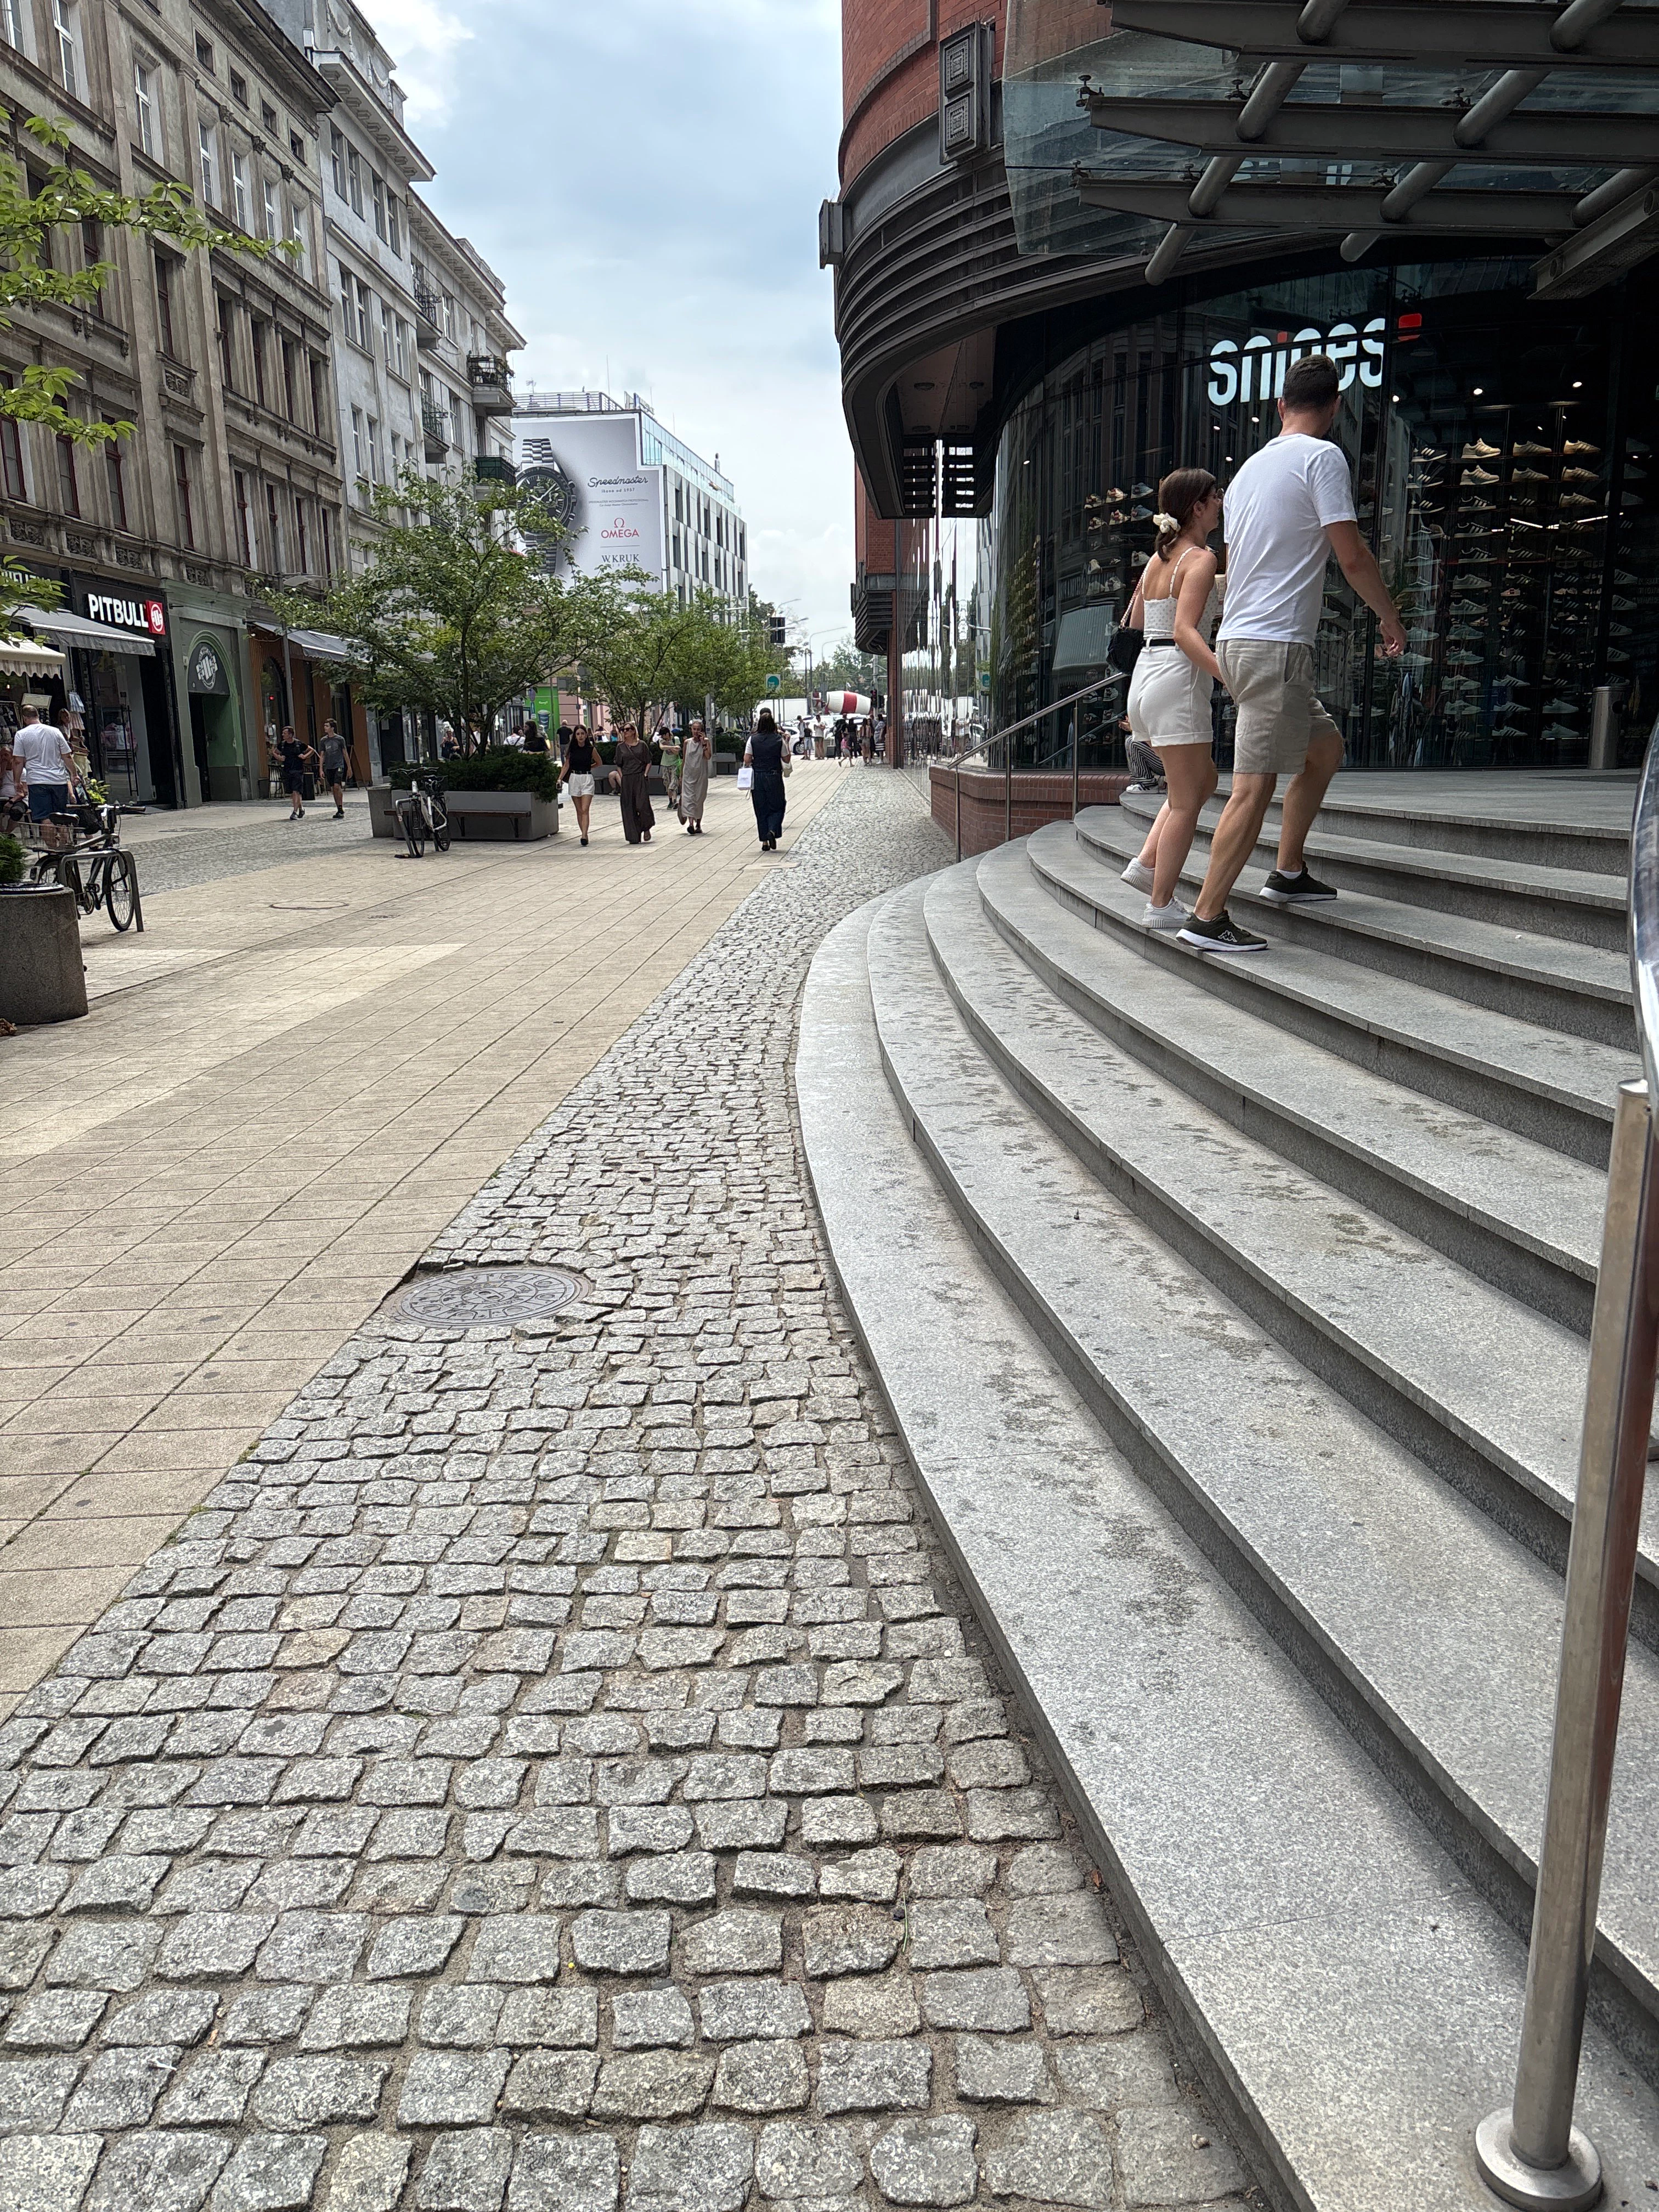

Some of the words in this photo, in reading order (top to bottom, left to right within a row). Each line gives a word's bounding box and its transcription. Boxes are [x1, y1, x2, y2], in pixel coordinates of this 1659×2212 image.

[588, 475, 648, 487] Speedmaster
[601, 528, 639, 538] OMEGA
[87, 593, 149, 628] PITBULL
